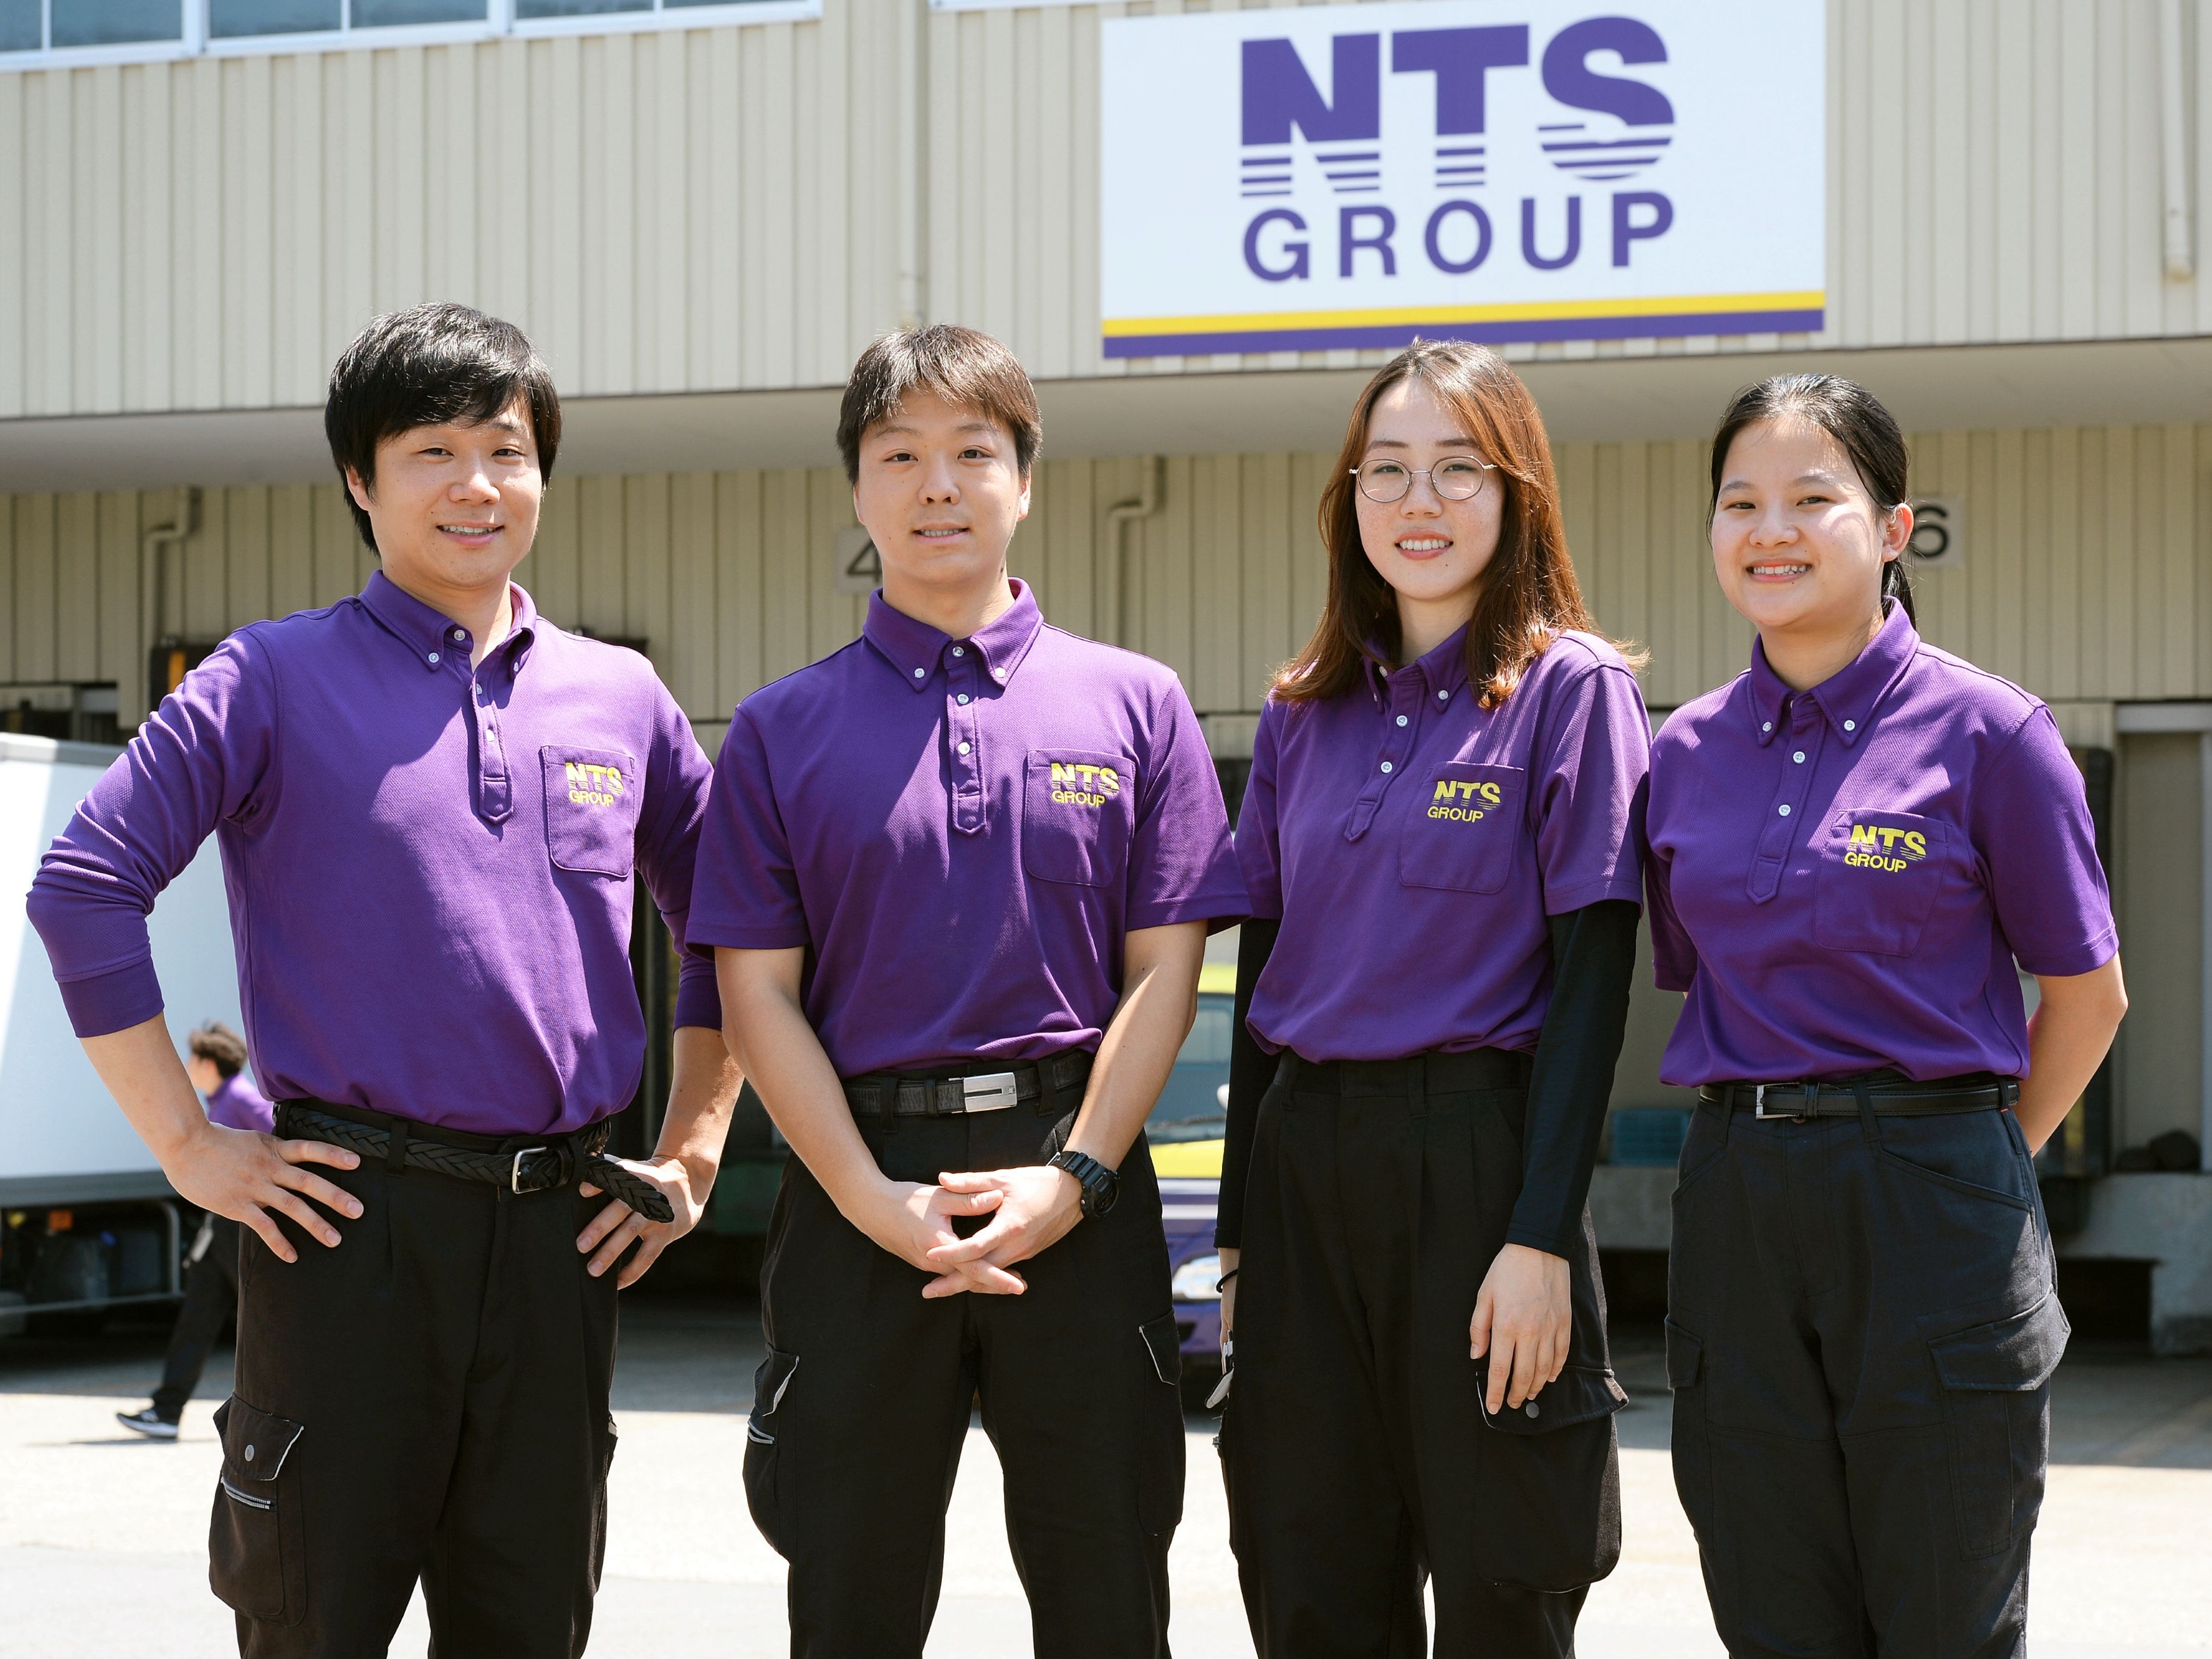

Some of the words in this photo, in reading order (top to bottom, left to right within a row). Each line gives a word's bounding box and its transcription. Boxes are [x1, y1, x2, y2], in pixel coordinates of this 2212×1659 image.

[1241, 16, 1675, 197] NTS
[1242, 191, 1675, 281] GROUP
[1912, 505, 1948, 558] 6
[846, 537, 883, 584] 4
[565, 762, 624, 795] NTS
[1051, 762, 1120, 795] NTS
[568, 790, 614, 807] GROUP
[1051, 790, 1106, 807] GROUP
[1431, 781, 1501, 810] NTS
[1427, 806, 1484, 823] GROUP
[1847, 824, 1927, 860] NTS
[1844, 852, 1907, 872] GROUP
